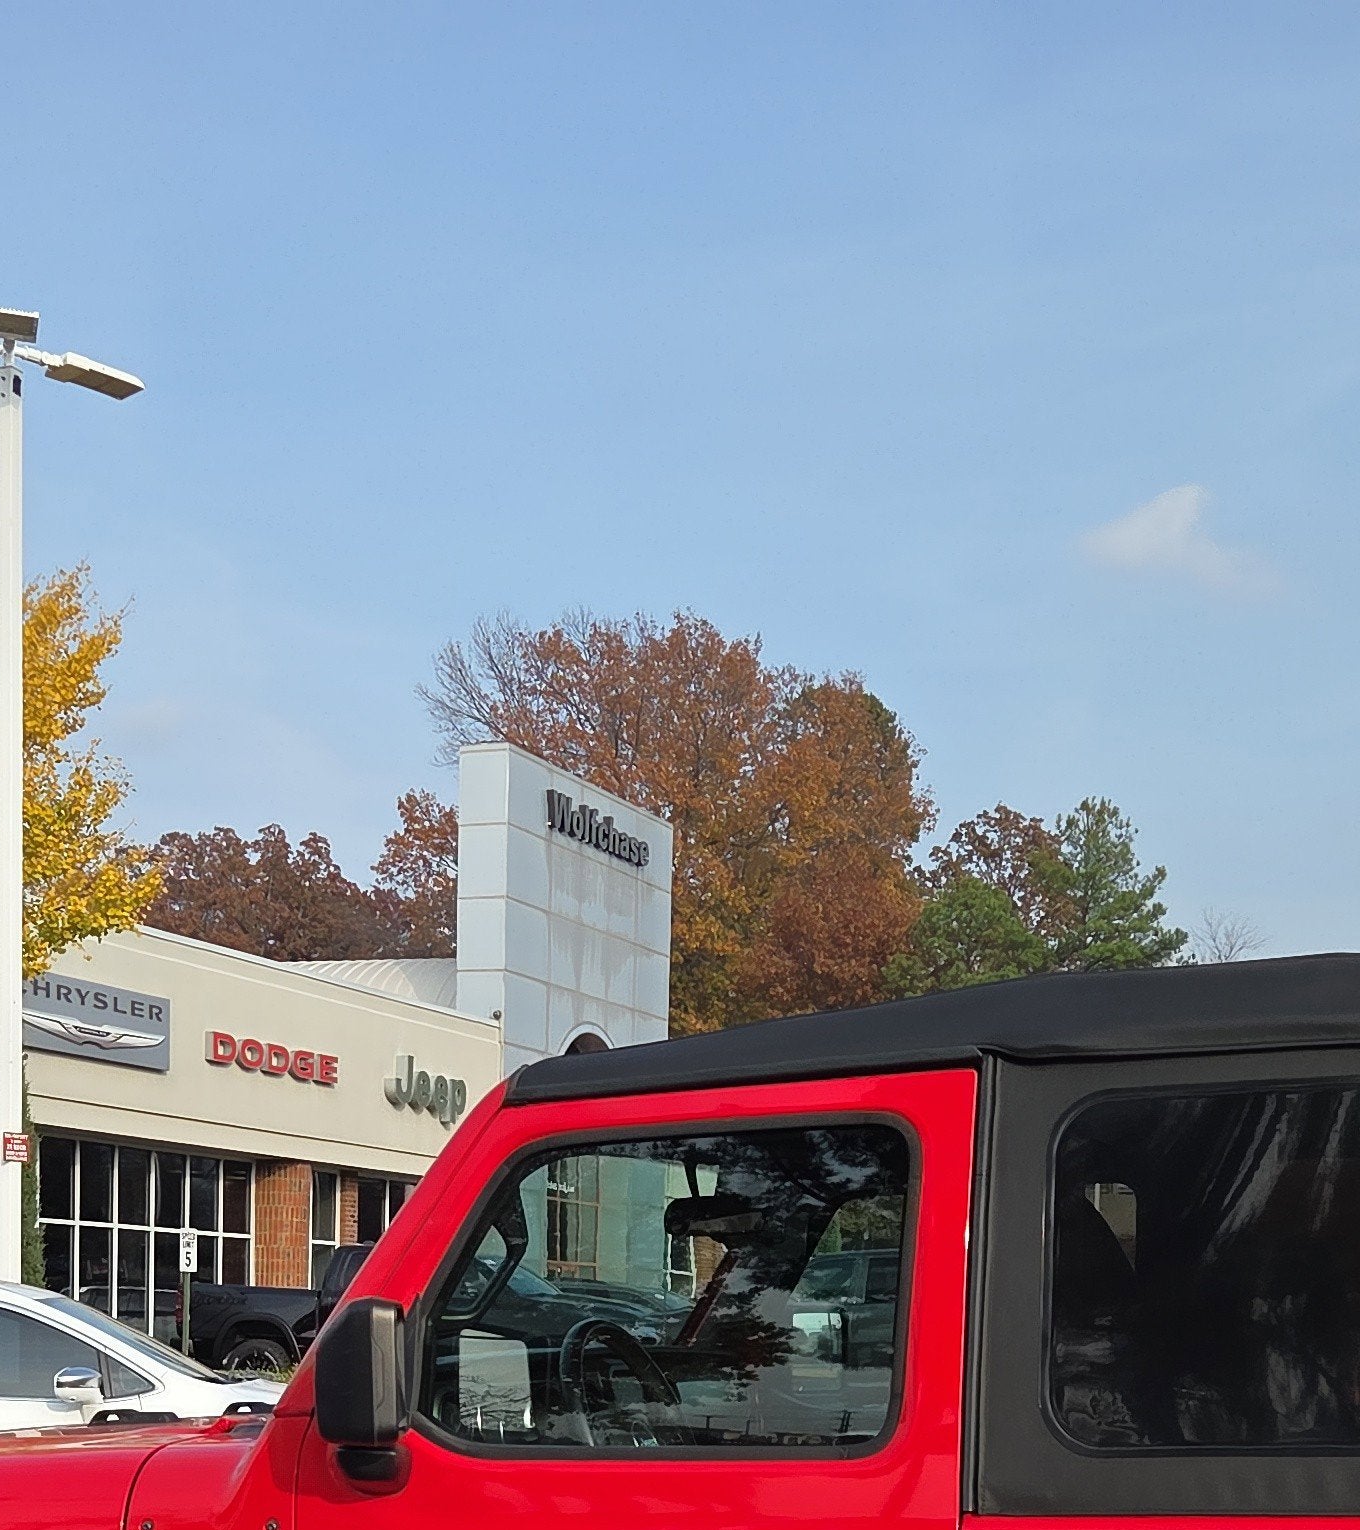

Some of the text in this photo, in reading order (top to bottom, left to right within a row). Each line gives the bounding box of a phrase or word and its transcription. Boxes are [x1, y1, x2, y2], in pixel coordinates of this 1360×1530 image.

[546, 789, 650, 867] Wolfchase
[24, 979, 163, 1022] HRYSLER
[205, 1031, 338, 1083] DODGE
[384, 1055, 466, 1124] Jeep
[185, 1251, 191, 1267] 5
